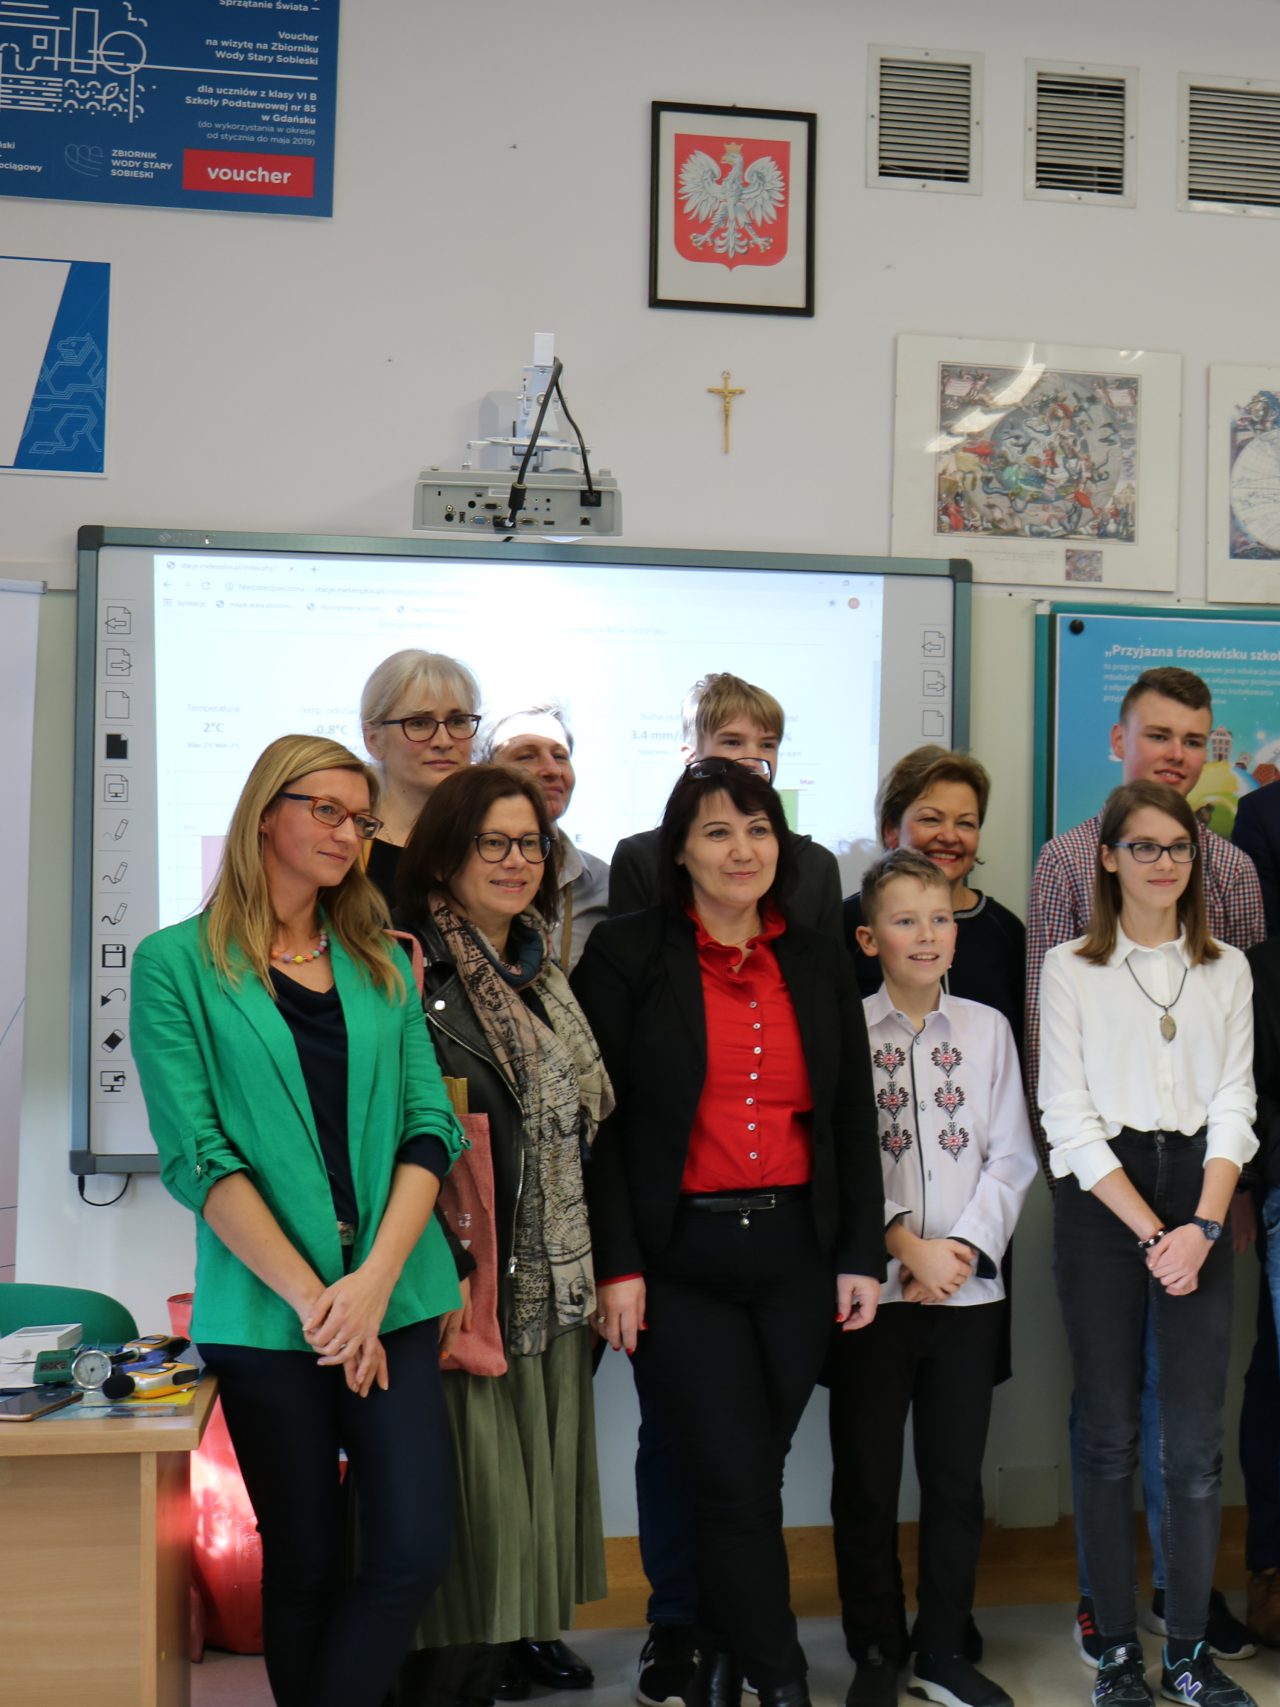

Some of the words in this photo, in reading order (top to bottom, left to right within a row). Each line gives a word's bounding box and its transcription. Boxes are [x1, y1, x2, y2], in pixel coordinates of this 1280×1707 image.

[219, 0, 273, 9] Sprzątanie
[275, 1, 309, 12] Świata
[278, 31, 319, 42] Voucher
[221, 39, 254, 50] wizytę
[256, 42, 268, 50] na
[271, 42, 319, 54] Zbiorniku
[215, 50, 245, 61] Wody
[247, 52, 274, 63] Stary
[276, 54, 318, 66] Sobieski
[197, 85, 214, 94] dla
[216, 86, 257, 97] uczniów
[268, 90, 294, 101] klasy
[297, 92, 307, 100] VI
[310, 93, 317, 101] B
[185, 96, 219, 107] Szkoły
[222, 98, 288, 112] Podstawowej
[304, 105, 317, 113] 85
[273, 113, 317, 125] Gdańsku
[197, 120, 213, 129] (do
[214, 122, 275, 133] wykorzystania
[286, 127, 316, 136] okresie
[206, 132, 219, 140] od
[220, 133, 255, 143] stycznia
[270, 137, 290, 145] maja
[292, 137, 316, 147] 2019)
[111, 149, 157, 159] ZBIORNIK
[111, 159, 141, 168] WODY
[143, 161, 173, 170] STARY
[110, 169, 154, 179] SOBIESKI
[207, 163, 292, 186] voucher
[1176, 645, 1248, 661] środowisku
[203, 722, 224, 733] 2°C
